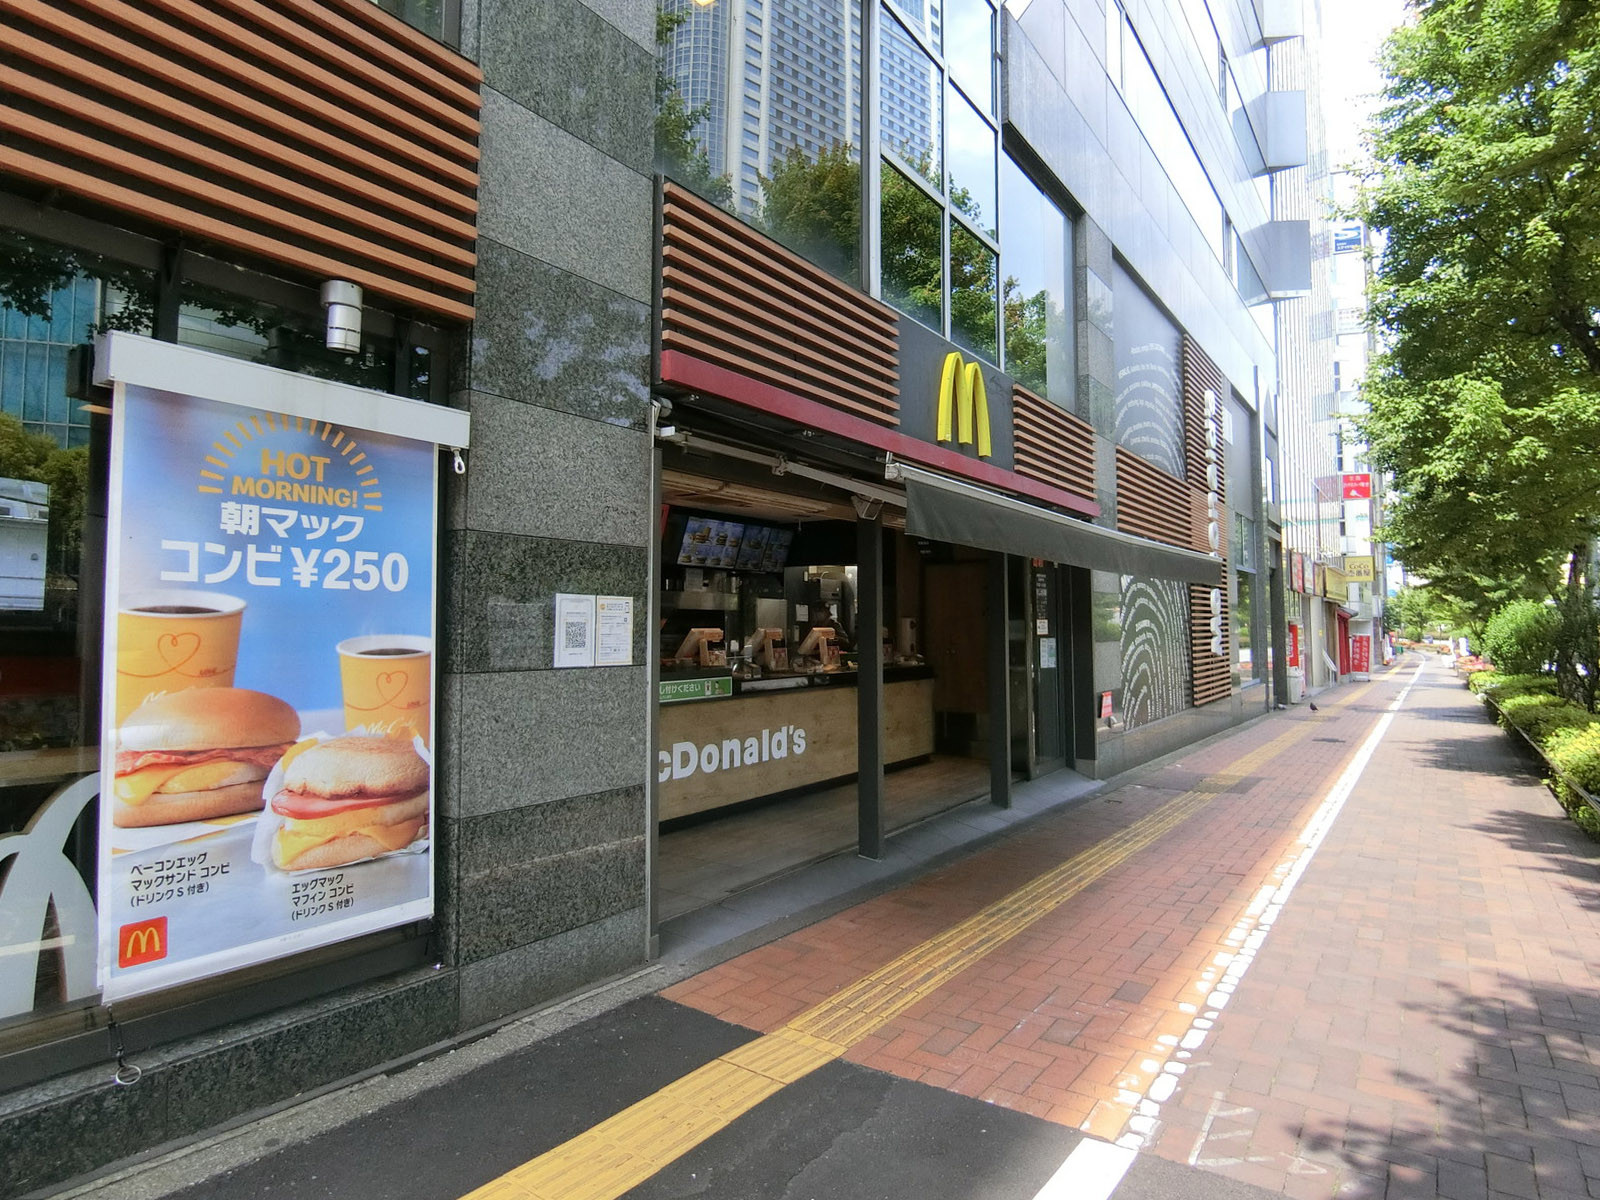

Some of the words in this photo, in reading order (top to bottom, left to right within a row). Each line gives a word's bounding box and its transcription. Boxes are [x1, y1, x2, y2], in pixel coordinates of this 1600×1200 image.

[261, 448, 331, 482] HOT
[231, 475, 358, 508] MORNING!
[220, 501, 364, 542] 朝マック
[160, 539, 282, 586] コンビ
[291, 546, 409, 592] ¥250
[660, 683, 701, 695] し付けください
[659, 725, 806, 783] cDonald's
[131, 852, 207, 876] ベーコンエッグ
[292, 873, 344, 894] エッグマック
